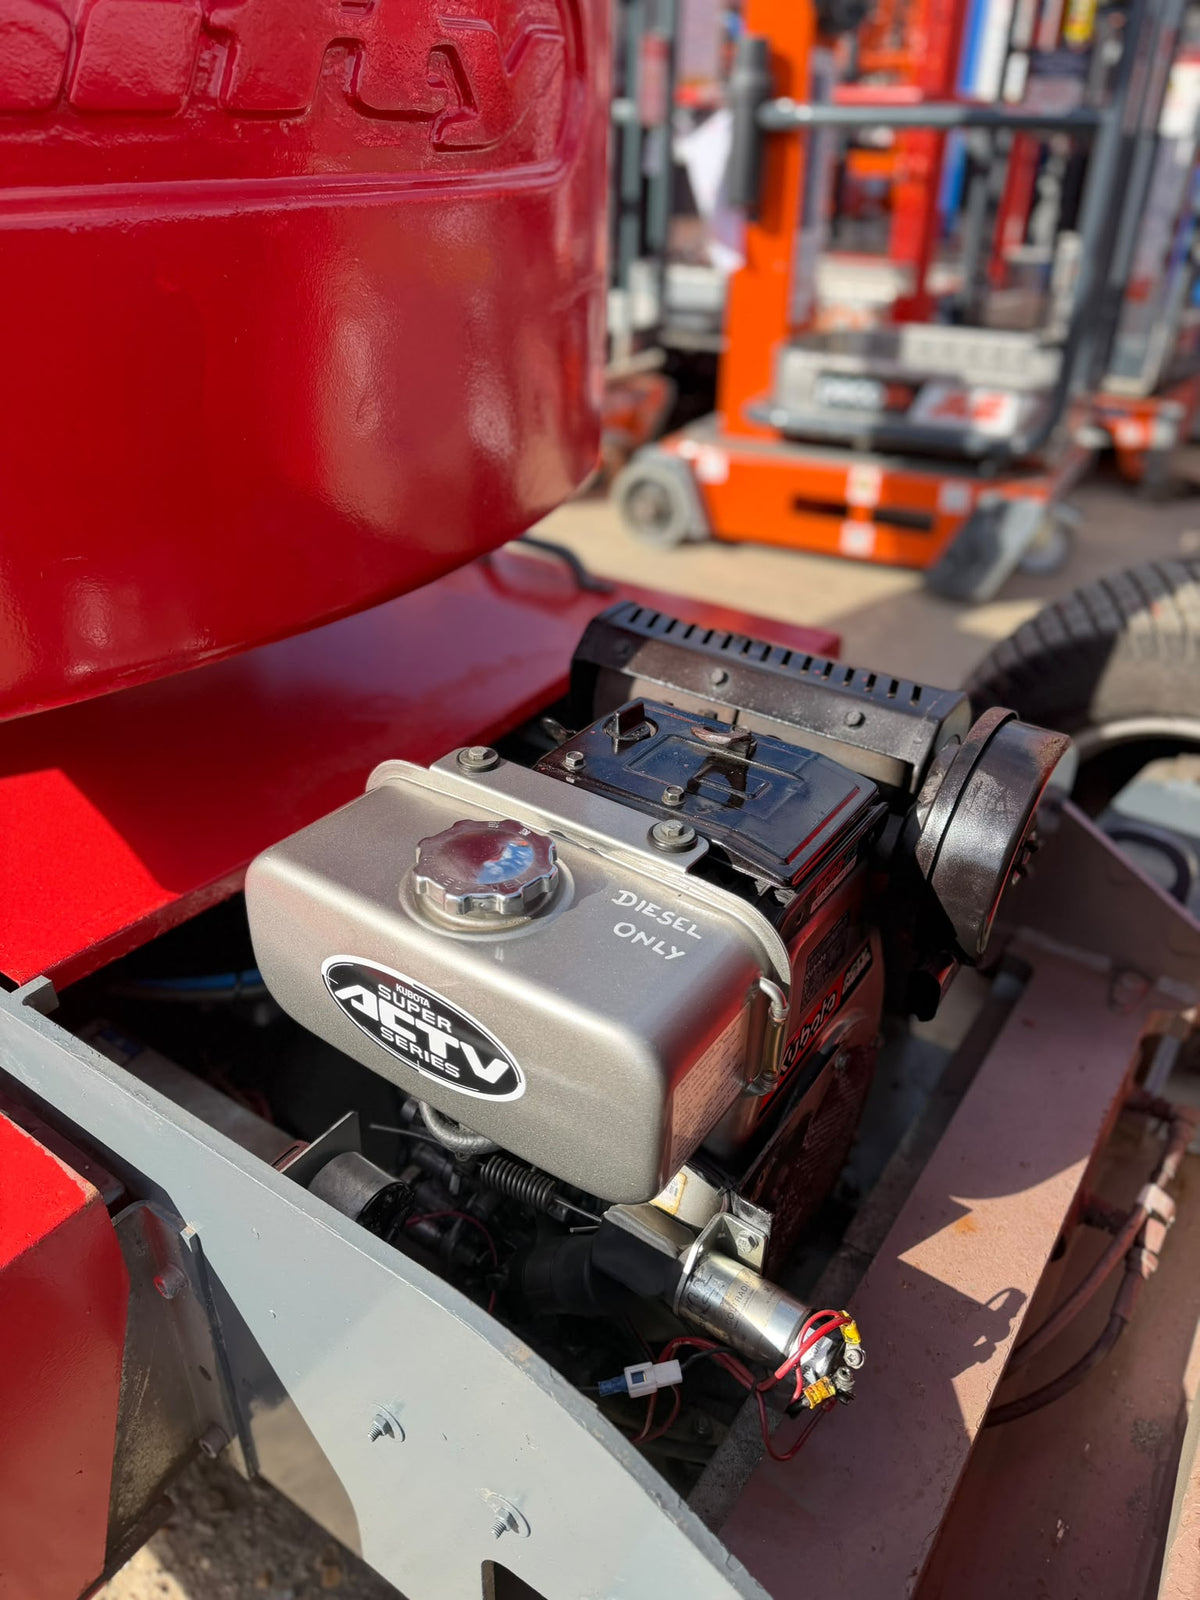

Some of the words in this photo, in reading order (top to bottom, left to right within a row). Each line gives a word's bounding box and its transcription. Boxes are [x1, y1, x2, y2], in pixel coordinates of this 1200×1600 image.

[611, 889, 702, 940] DIESEL
[613, 922, 686, 960] ONLY
[378, 984, 453, 1034] SUPER
[395, 983, 431, 1009] KUBOTA
[335, 984, 509, 1084] ACTV
[380, 1026, 461, 1079] SERIES
